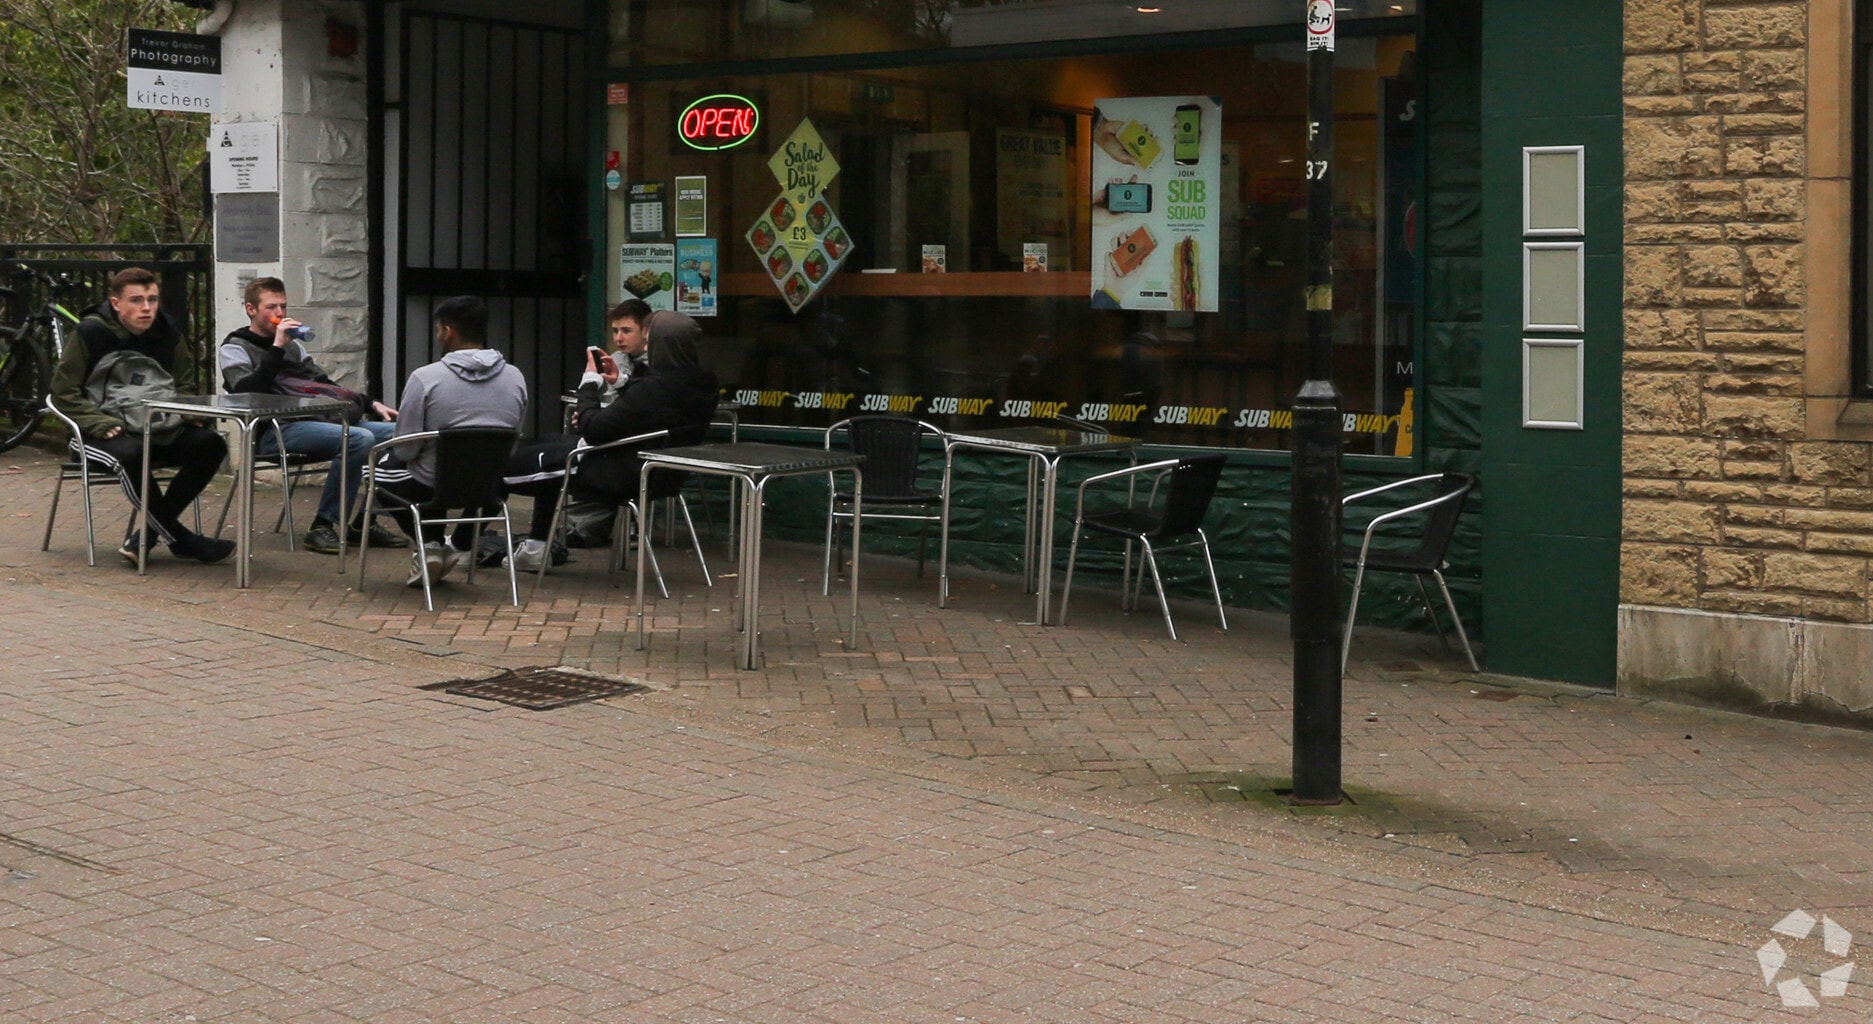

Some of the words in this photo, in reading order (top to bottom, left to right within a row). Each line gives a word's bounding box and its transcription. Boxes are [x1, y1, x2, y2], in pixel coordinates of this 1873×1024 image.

[171, 40, 205, 50] Graham
[130, 48, 217, 67] Photography
[136, 90, 210, 108] kitchens
[683, 108, 752, 138] OPEN
[1309, 122, 1319, 141] F
[784, 141, 825, 167] Salad
[797, 162, 805, 174] of
[806, 161, 818, 172] the
[1306, 161, 1328, 179] 37
[630, 183, 659, 194] SUBWAY
[788, 167, 820, 199] Day
[1168, 179, 1206, 203] SUB
[1167, 206, 1206, 220] SQUAD
[793, 226, 806, 241] £3
[650, 247, 673, 256] Platters
[731, 389, 790, 408] SUBWAY
[795, 391, 855, 410] SUBWAY
[859, 393, 923, 413] SUBWAY
[928, 396, 994, 416] SUBWAY
[999, 398, 1068, 419] SUBWAY
[1076, 403, 1148, 422] SUBWAY
[1153, 405, 1228, 425] SUBWAY
[1234, 409, 1292, 429] SUBWA
[1343, 413, 1400, 434] BWAY
